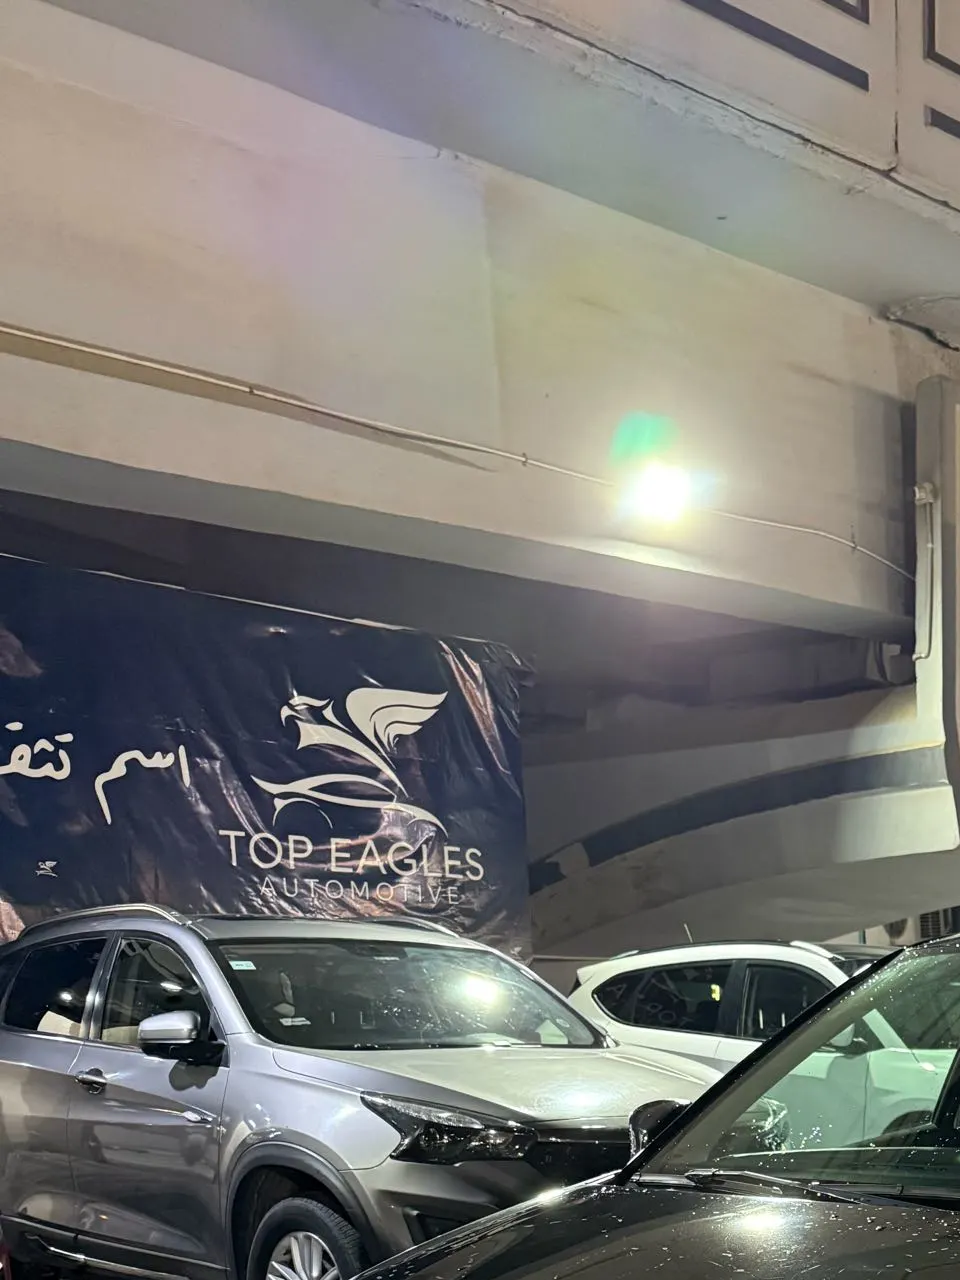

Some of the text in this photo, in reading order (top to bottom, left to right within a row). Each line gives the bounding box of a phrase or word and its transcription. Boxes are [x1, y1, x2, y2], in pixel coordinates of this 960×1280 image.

[95, 745, 190, 825] اسم
[218, 829, 485, 881] TOP EAGLES
[259, 876, 461, 905] AUTOMOTIVE
